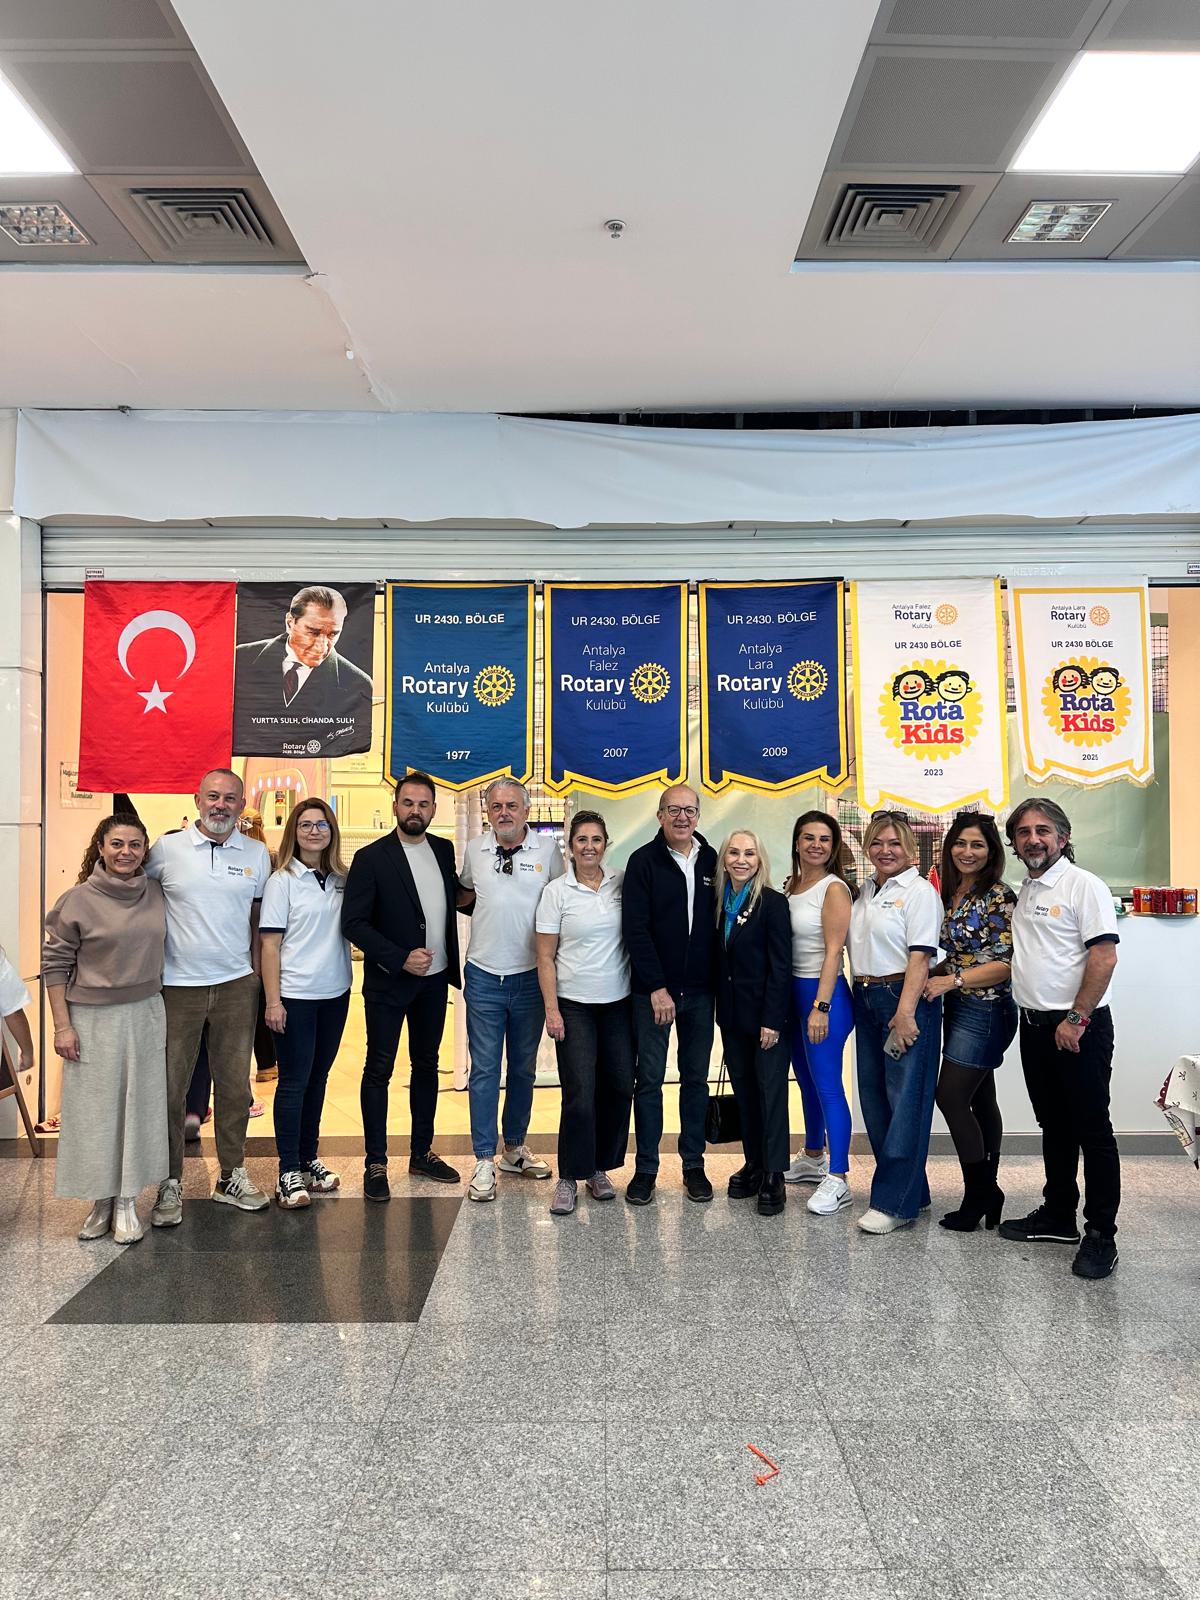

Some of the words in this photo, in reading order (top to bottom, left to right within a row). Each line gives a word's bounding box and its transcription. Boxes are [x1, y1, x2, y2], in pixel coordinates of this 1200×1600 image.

[415, 614, 431, 624] UR
[434, 614, 462, 625] 2430.
[465, 612, 505, 624] BÖLGE
[572, 616, 588, 626] UR
[590, 616, 618, 626] 2430.
[622, 614, 660, 626] BÖLGE
[727, 615, 744, 624] UR
[746, 614, 774, 624] 2430.
[777, 612, 817, 624] BÖLGE
[894, 610, 932, 621] Rotary
[1050, 610, 1086, 622] Rotary
[738, 642, 782, 656] Antalya
[894, 641, 908, 649] UR
[909, 641, 929, 649] 2430
[930, 640, 962, 649] BÖLGE
[1051, 640, 1063, 648] UR
[1065, 640, 1083, 648] 2430
[1085, 639, 1114, 648] BÖLGE
[582, 644, 626, 658] Antalya
[424, 662, 470, 676] Antalya
[590, 660, 618, 671] Falez
[748, 659, 774, 670] Lara
[402, 676, 468, 698] Rotary
[560, 674, 625, 695] Rotary
[717, 674, 782, 693] Rotary
[426, 702, 470, 713] Kulübü
[586, 700, 626, 710] Kulübü
[744, 698, 784, 710] Kulübü
[1060, 694, 1114, 712] Rota
[900, 702, 964, 721] Rota
[280, 717, 301, 725] SULH,
[301, 716, 334, 724] CİHANDA
[1060, 712, 1116, 732] Kids
[900, 722, 965, 744] Kids
[282, 743, 306, 751] Rotary
[603, 748, 628, 758] 2007
[762, 747, 788, 757] 2009
[446, 751, 471, 760] 1977
[924, 769, 944, 777] 2023
